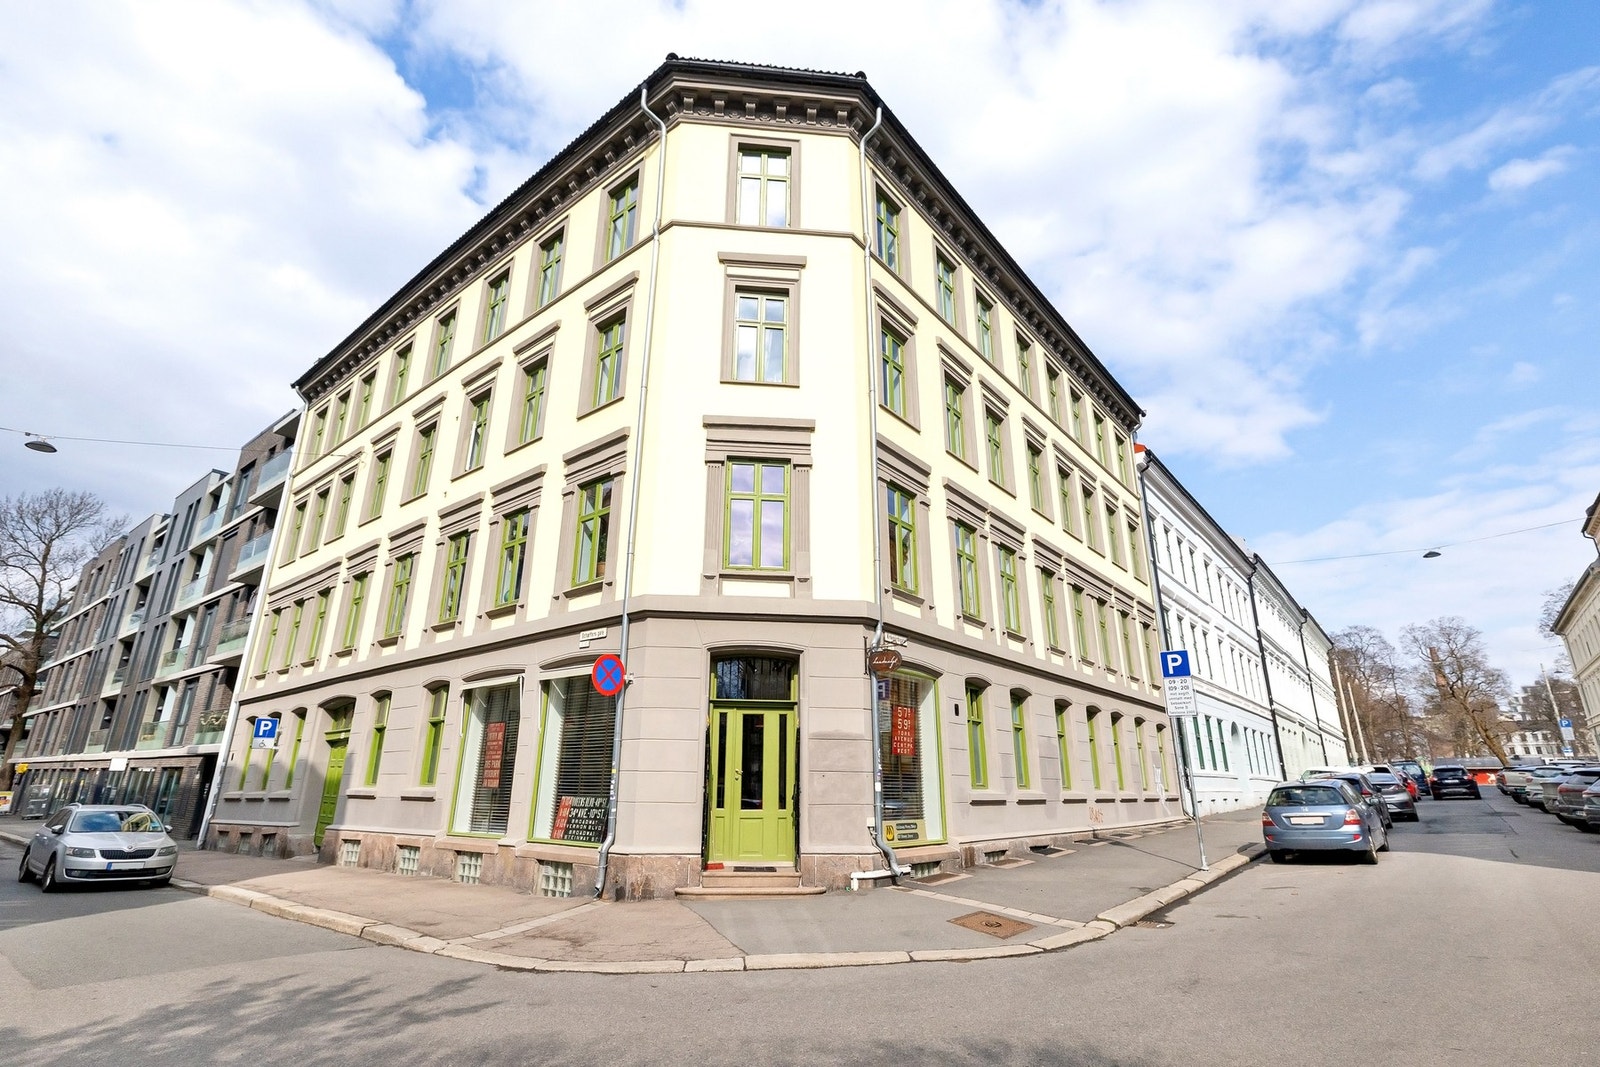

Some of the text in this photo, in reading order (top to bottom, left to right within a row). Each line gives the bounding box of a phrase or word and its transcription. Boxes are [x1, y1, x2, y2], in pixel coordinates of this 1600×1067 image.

[1166, 654, 1182, 675] P
[897, 706, 908, 718] 57
[258, 720, 273, 736] P
[897, 718, 908, 730] 59
